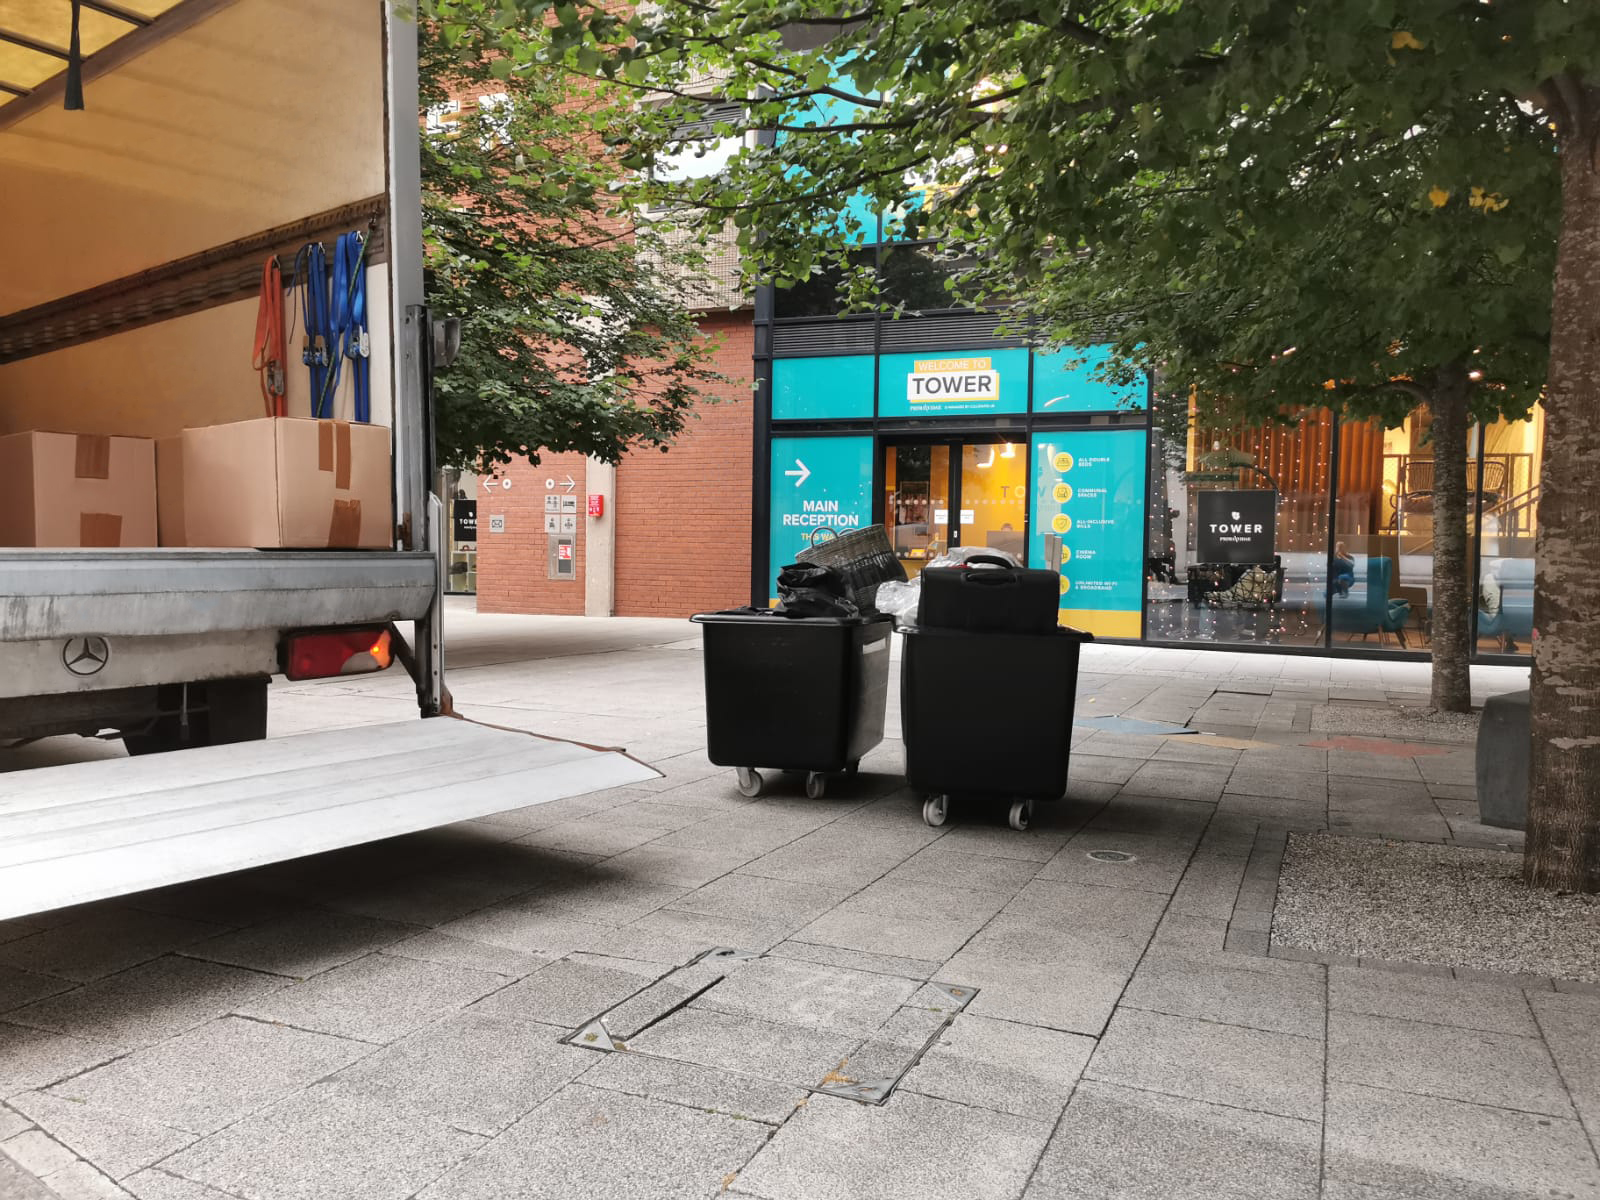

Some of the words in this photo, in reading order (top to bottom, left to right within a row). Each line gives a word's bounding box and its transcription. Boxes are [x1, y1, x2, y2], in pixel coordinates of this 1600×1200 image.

[918, 360, 969, 371] WELCOME
[973, 359, 987, 369] TO
[912, 375, 992, 394] TOWER
[803, 500, 839, 512] MAIN
[783, 514, 859, 526] RECEPTION
[1209, 524, 1263, 534] TOWER
